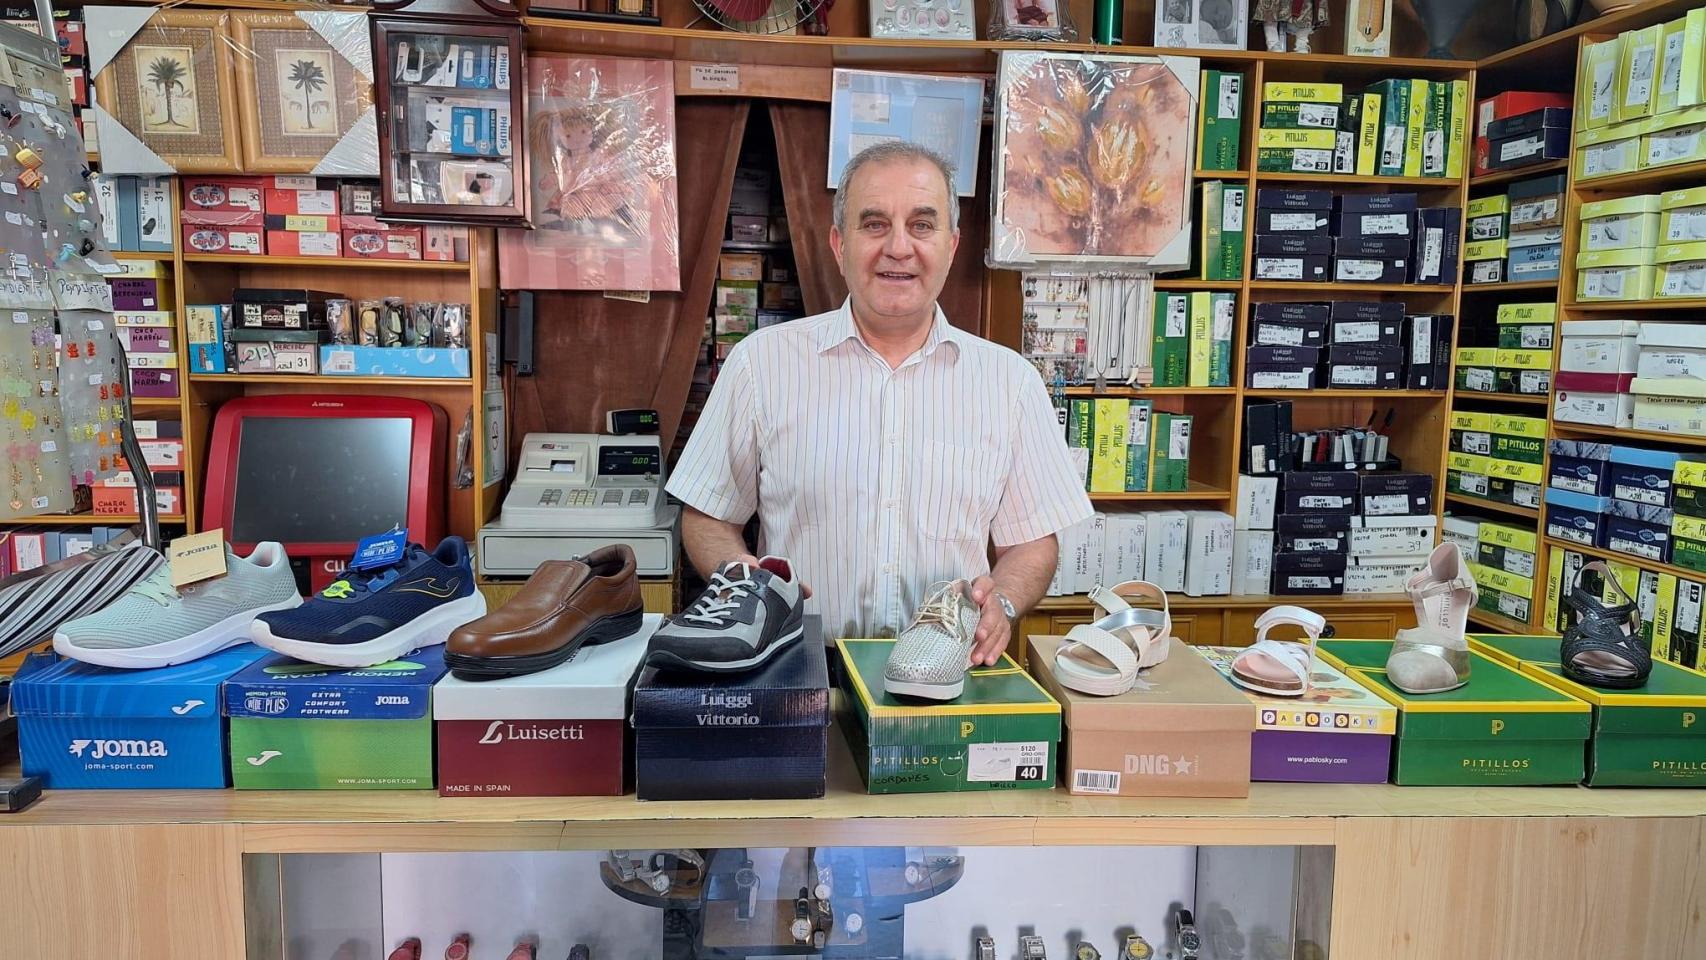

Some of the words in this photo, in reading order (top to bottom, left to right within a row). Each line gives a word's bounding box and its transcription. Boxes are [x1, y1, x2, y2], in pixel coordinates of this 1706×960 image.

[500, 53, 508, 85] PHILIPS
[1293, 88, 1315, 98] PITILLOS
[1285, 132, 1308, 142] PITILLOS
[1364, 122, 1375, 147] PITILLOS
[1411, 127, 1420, 152] PITILLOS
[102, 185, 111, 197] 32
[155, 190, 164, 202] 31
[1672, 230, 1680, 238] 39
[297, 358, 308, 367] 31
[1508, 421, 1526, 431] PITILLOS
[1113, 425, 1123, 448] PITILLOS
[1099, 434, 1108, 458] PITILLOS
[1509, 439, 1539, 451] PITILLOS
[1095, 518, 1104, 530] 39
[1496, 531, 1513, 543] PITILLOS
[1407, 541, 1421, 552] 39
[1491, 574, 1508, 587] PITILLOS
[1691, 586, 1700, 599] 41
[1657, 608, 1668, 637] PITILLOS
[246, 698, 262, 711] WIDE
[265, 698, 286, 713] PLUS
[700, 692, 753, 709] Luiggi
[696, 714, 760, 726] Vittorio
[1264, 712, 1375, 727] PABLOSKY
[1683, 712, 1696, 728] P
[507, 724, 584, 740] Luisetti
[960, 721, 975, 738] P
[1491, 719, 1504, 735] P
[85, 763, 154, 771] joma-sport.com
[874, 757, 938, 765] PITILLOS
[1124, 754, 1169, 775] DNG
[1463, 759, 1529, 768] PITILLOS
[1653, 761, 1706, 770] PITILLO
[1020, 767, 1038, 779] 40
